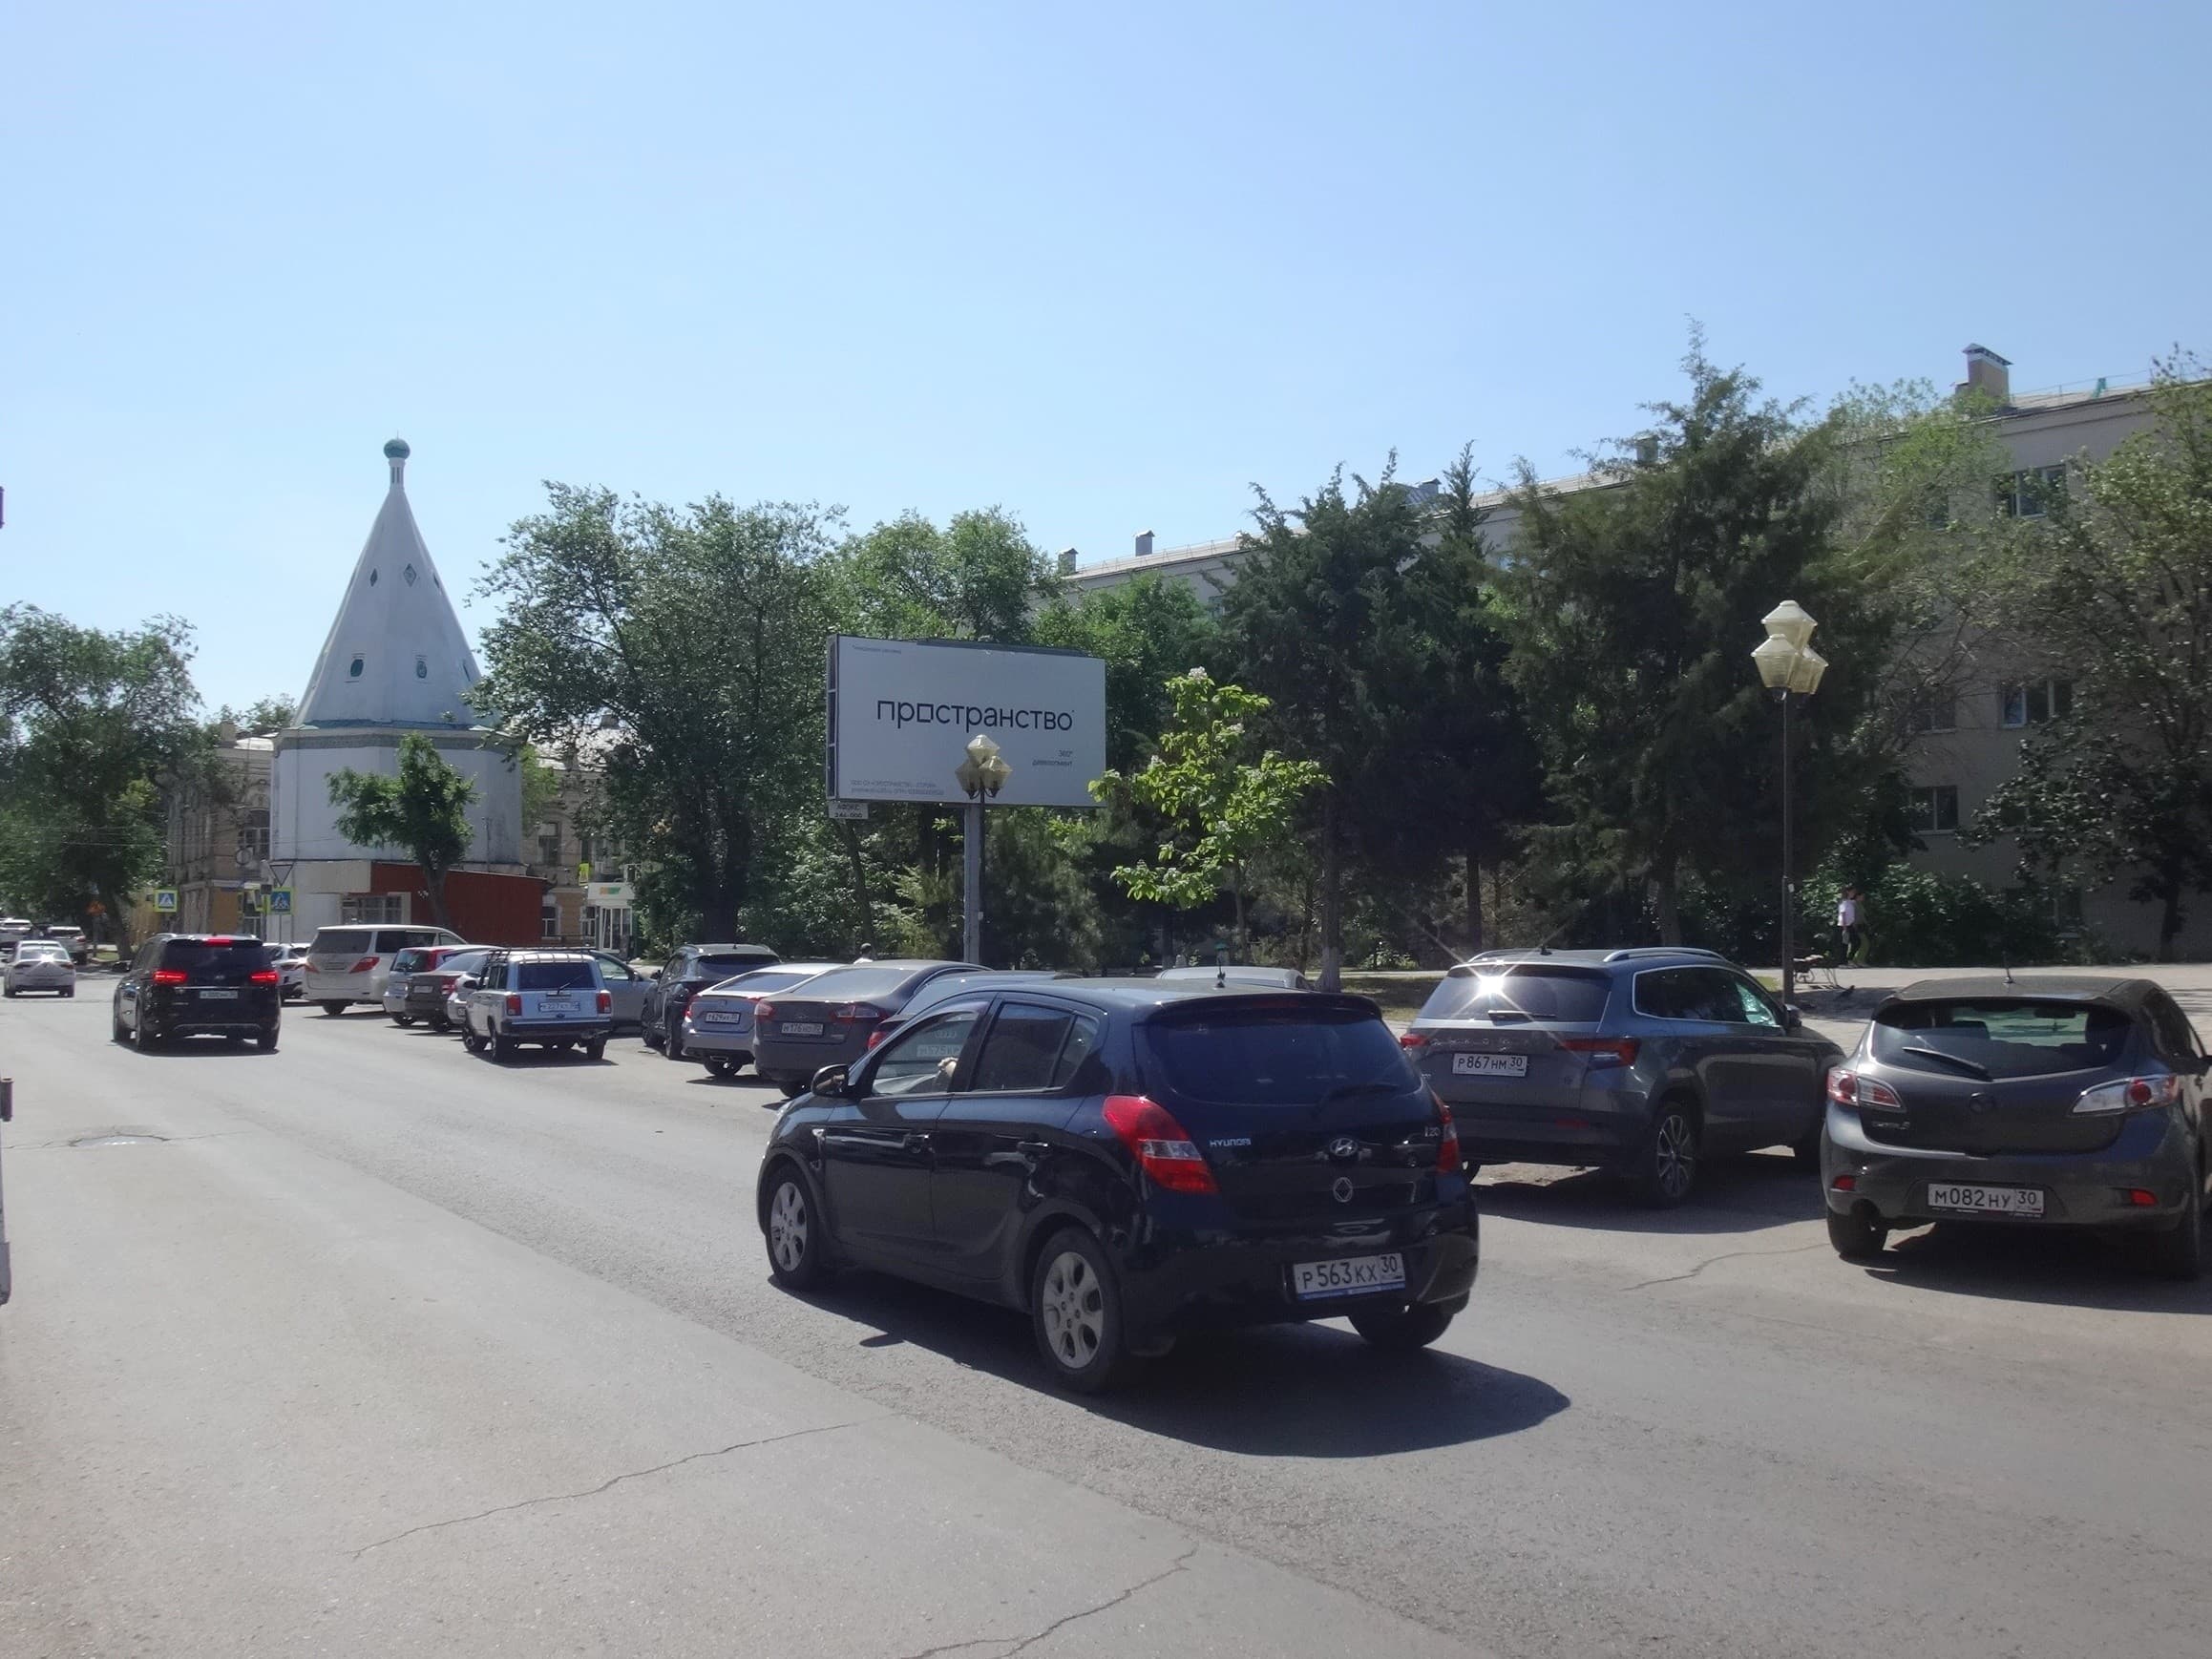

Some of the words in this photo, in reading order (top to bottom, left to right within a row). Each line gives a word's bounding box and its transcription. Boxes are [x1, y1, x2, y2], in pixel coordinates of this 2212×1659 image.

[876, 700, 1073, 733] пространство
[1457, 1055, 1507, 1070] Р867НМ
[1509, 1057, 1523, 1068] 30
[1209, 1138, 1252, 1147] HYUNDAI
[1934, 1187, 2011, 1208] М082НУ
[2017, 1190, 2037, 1206] 30
[1302, 1262, 1378, 1290] Р563КХ
[1380, 1255, 1398, 1273] 30
